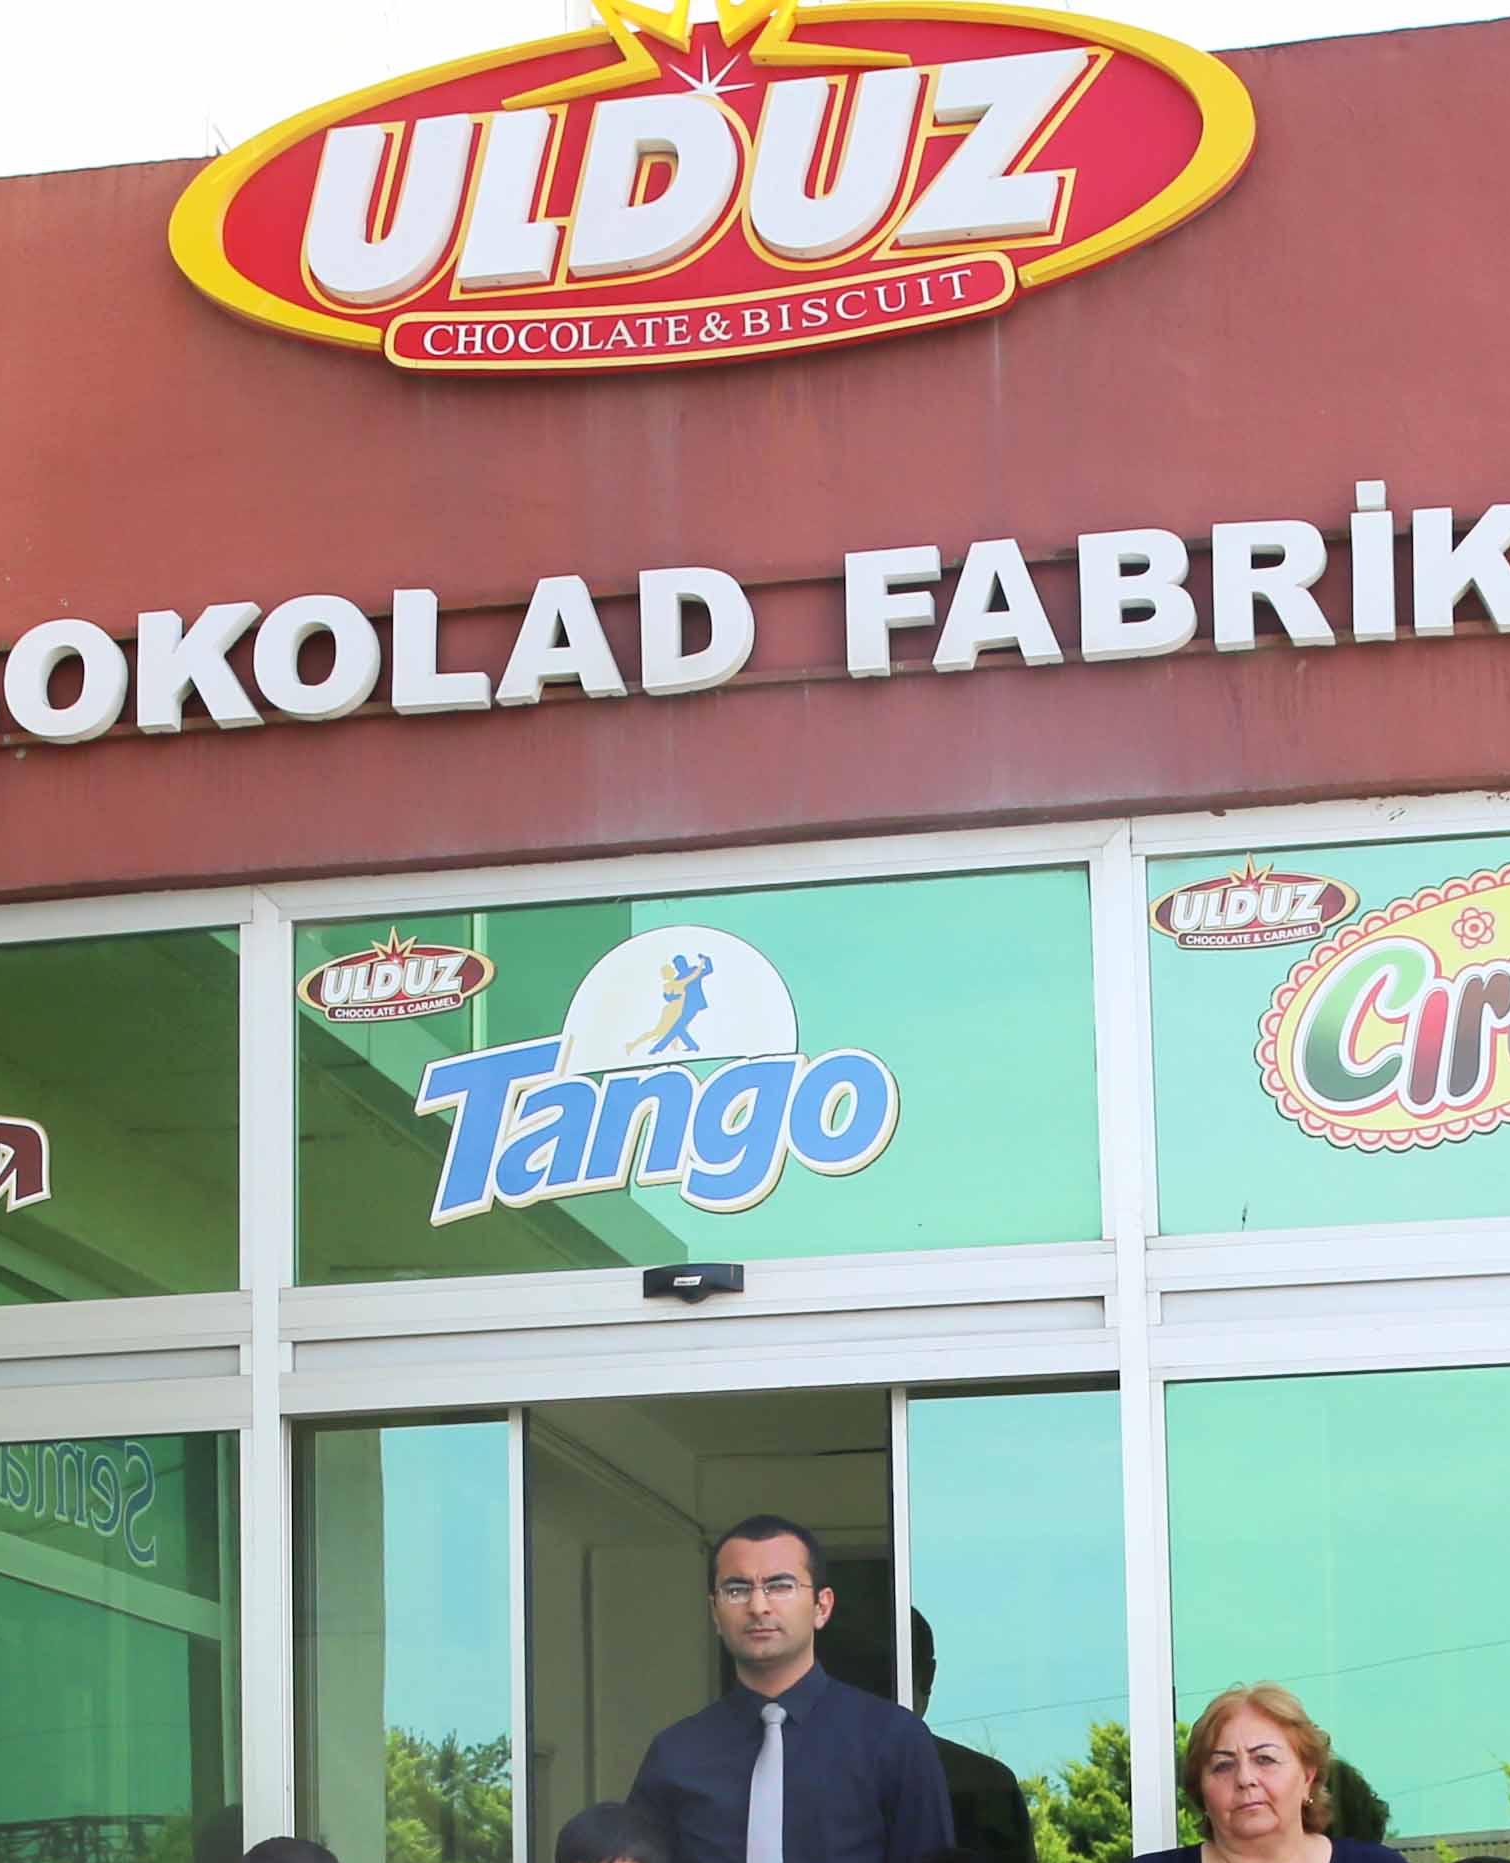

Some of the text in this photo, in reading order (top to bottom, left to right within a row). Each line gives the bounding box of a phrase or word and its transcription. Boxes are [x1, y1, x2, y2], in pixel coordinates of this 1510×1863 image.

[302, 44, 1114, 308] ULDUZ
[1170, 882, 1325, 931] ULDUZ
[1186, 934, 1251, 945] CHOCOLATE
[1263, 926, 1316, 942] CARAMEL
[321, 954, 468, 1004] ULDUZ
[335, 1007, 395, 1018] CHOCOLATE
[407, 997, 457, 1014] CARAMEL
[414, 1034, 899, 1227] Tango
